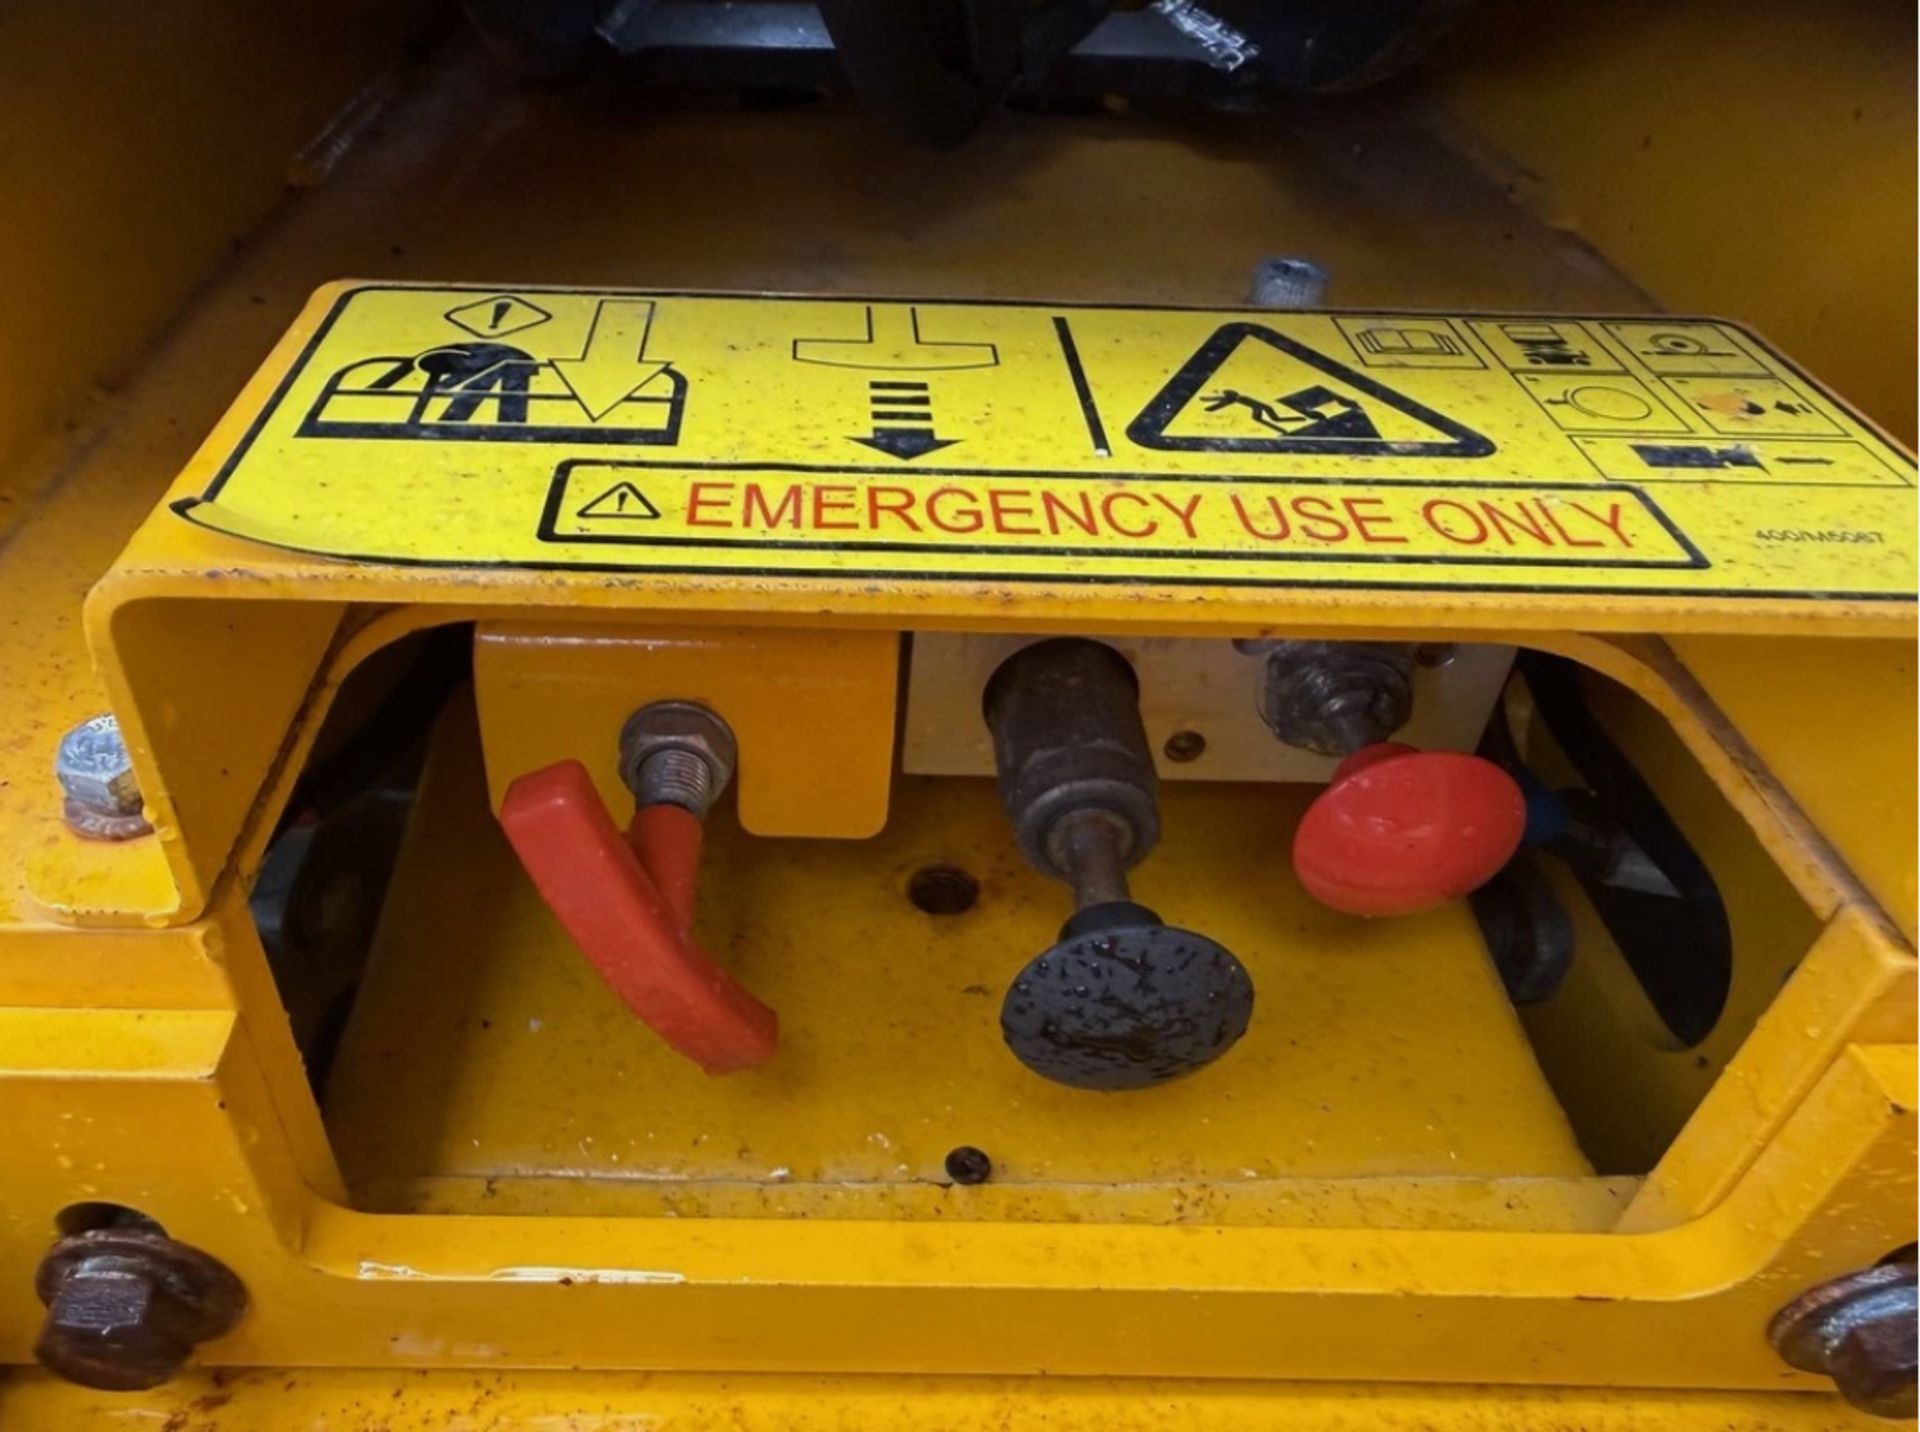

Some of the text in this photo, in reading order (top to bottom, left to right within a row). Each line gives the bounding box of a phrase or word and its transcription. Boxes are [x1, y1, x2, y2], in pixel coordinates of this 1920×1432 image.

[685, 481, 1635, 548] EMERGENCY USE ONLY
